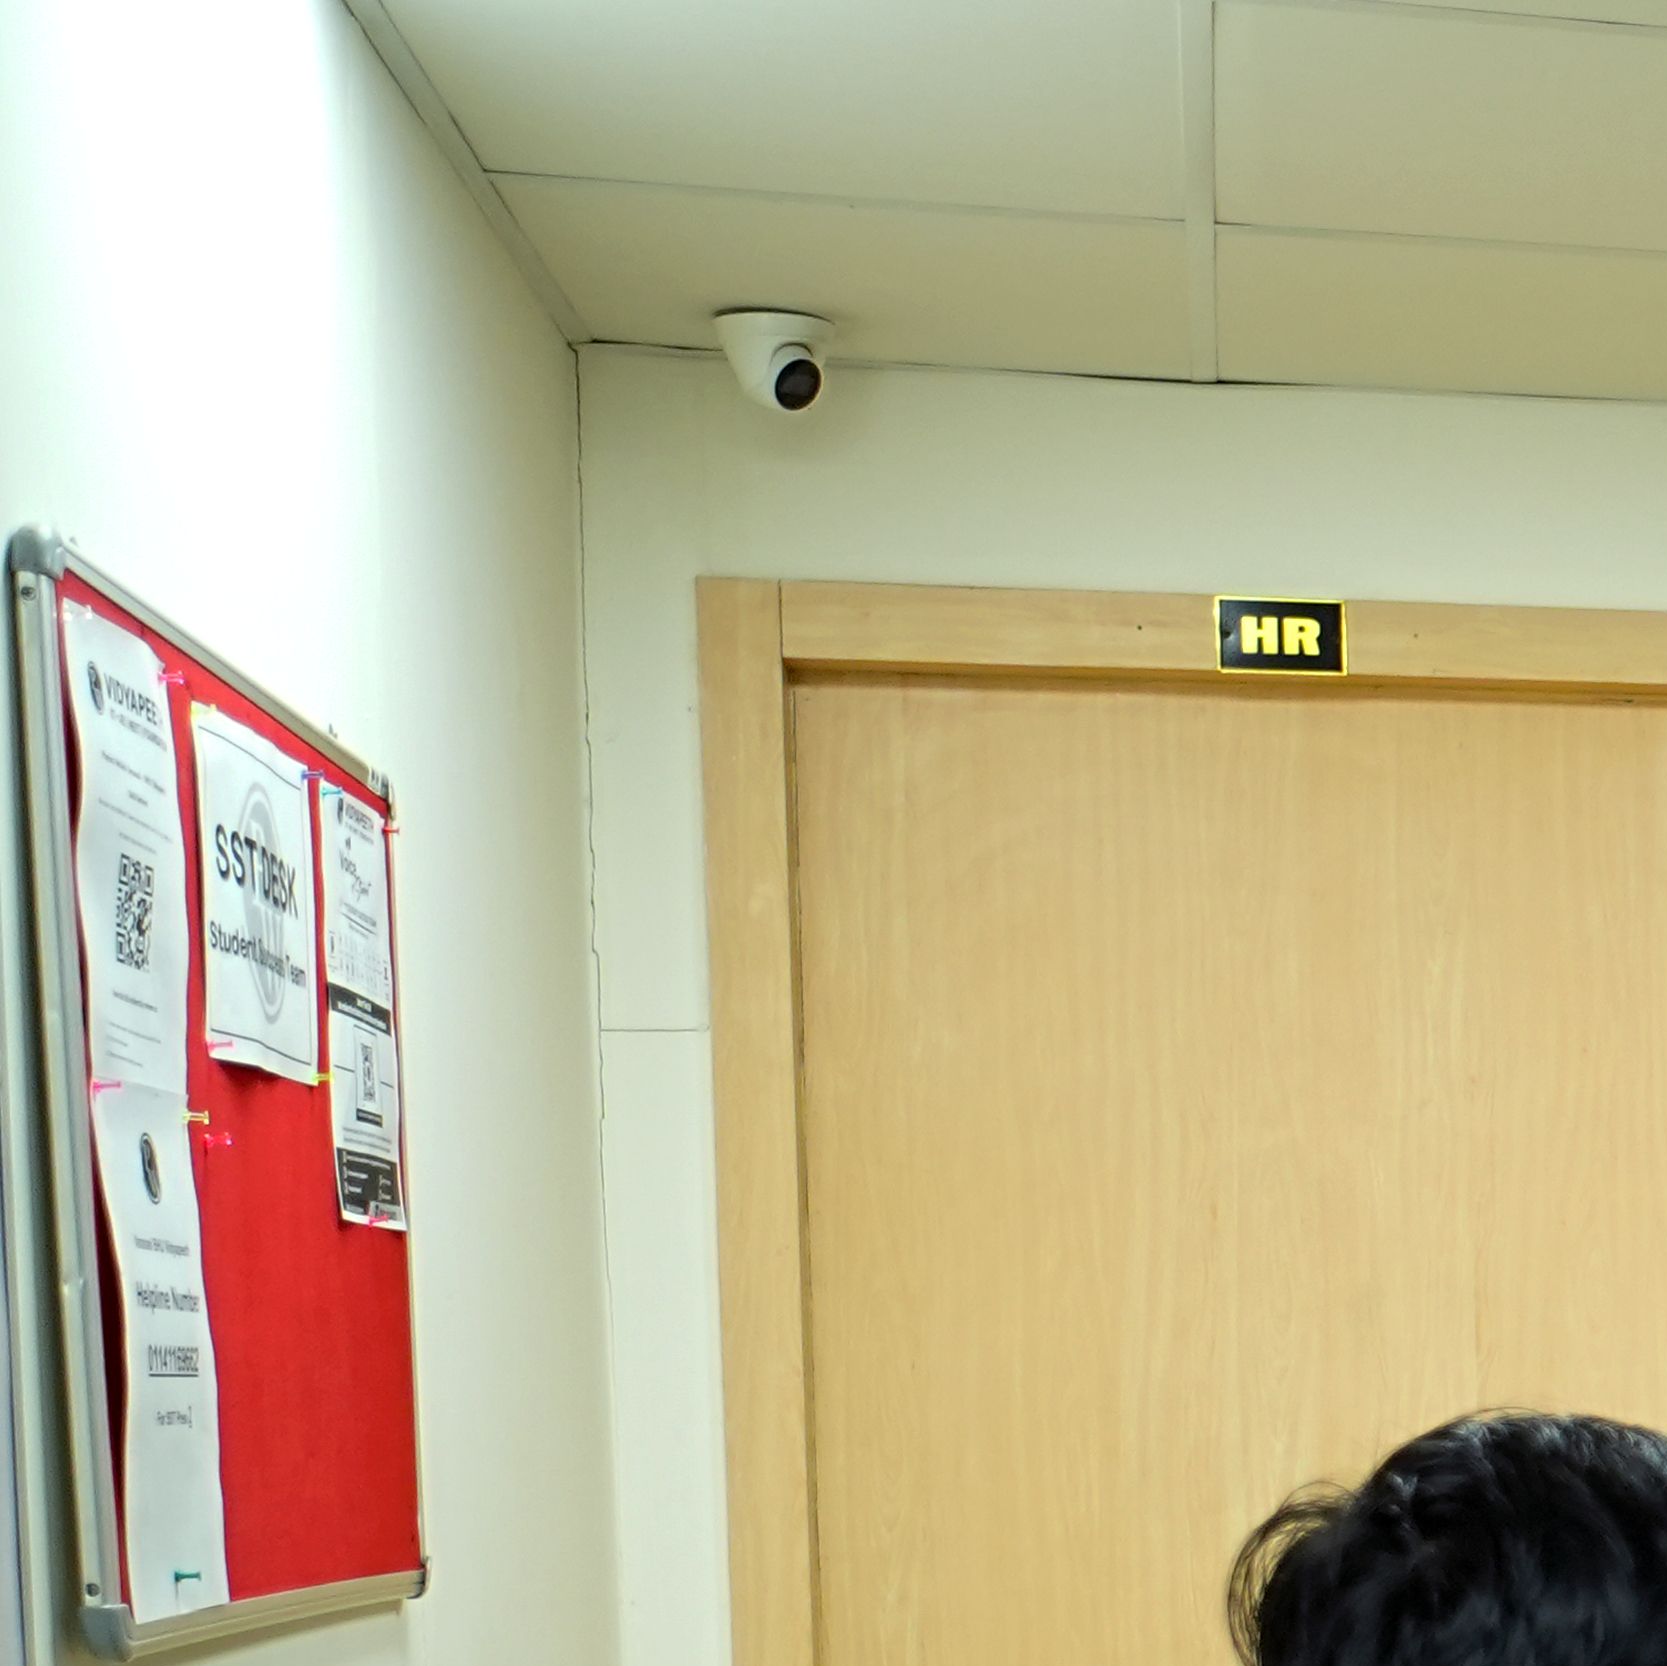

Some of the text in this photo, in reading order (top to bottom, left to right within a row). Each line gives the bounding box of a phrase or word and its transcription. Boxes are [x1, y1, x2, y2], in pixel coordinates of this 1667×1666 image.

[1240, 616, 1320, 656] HR
[215, 823, 258, 895] SST
[261, 846, 298, 920] DESK
[210, 920, 258, 963] Student
